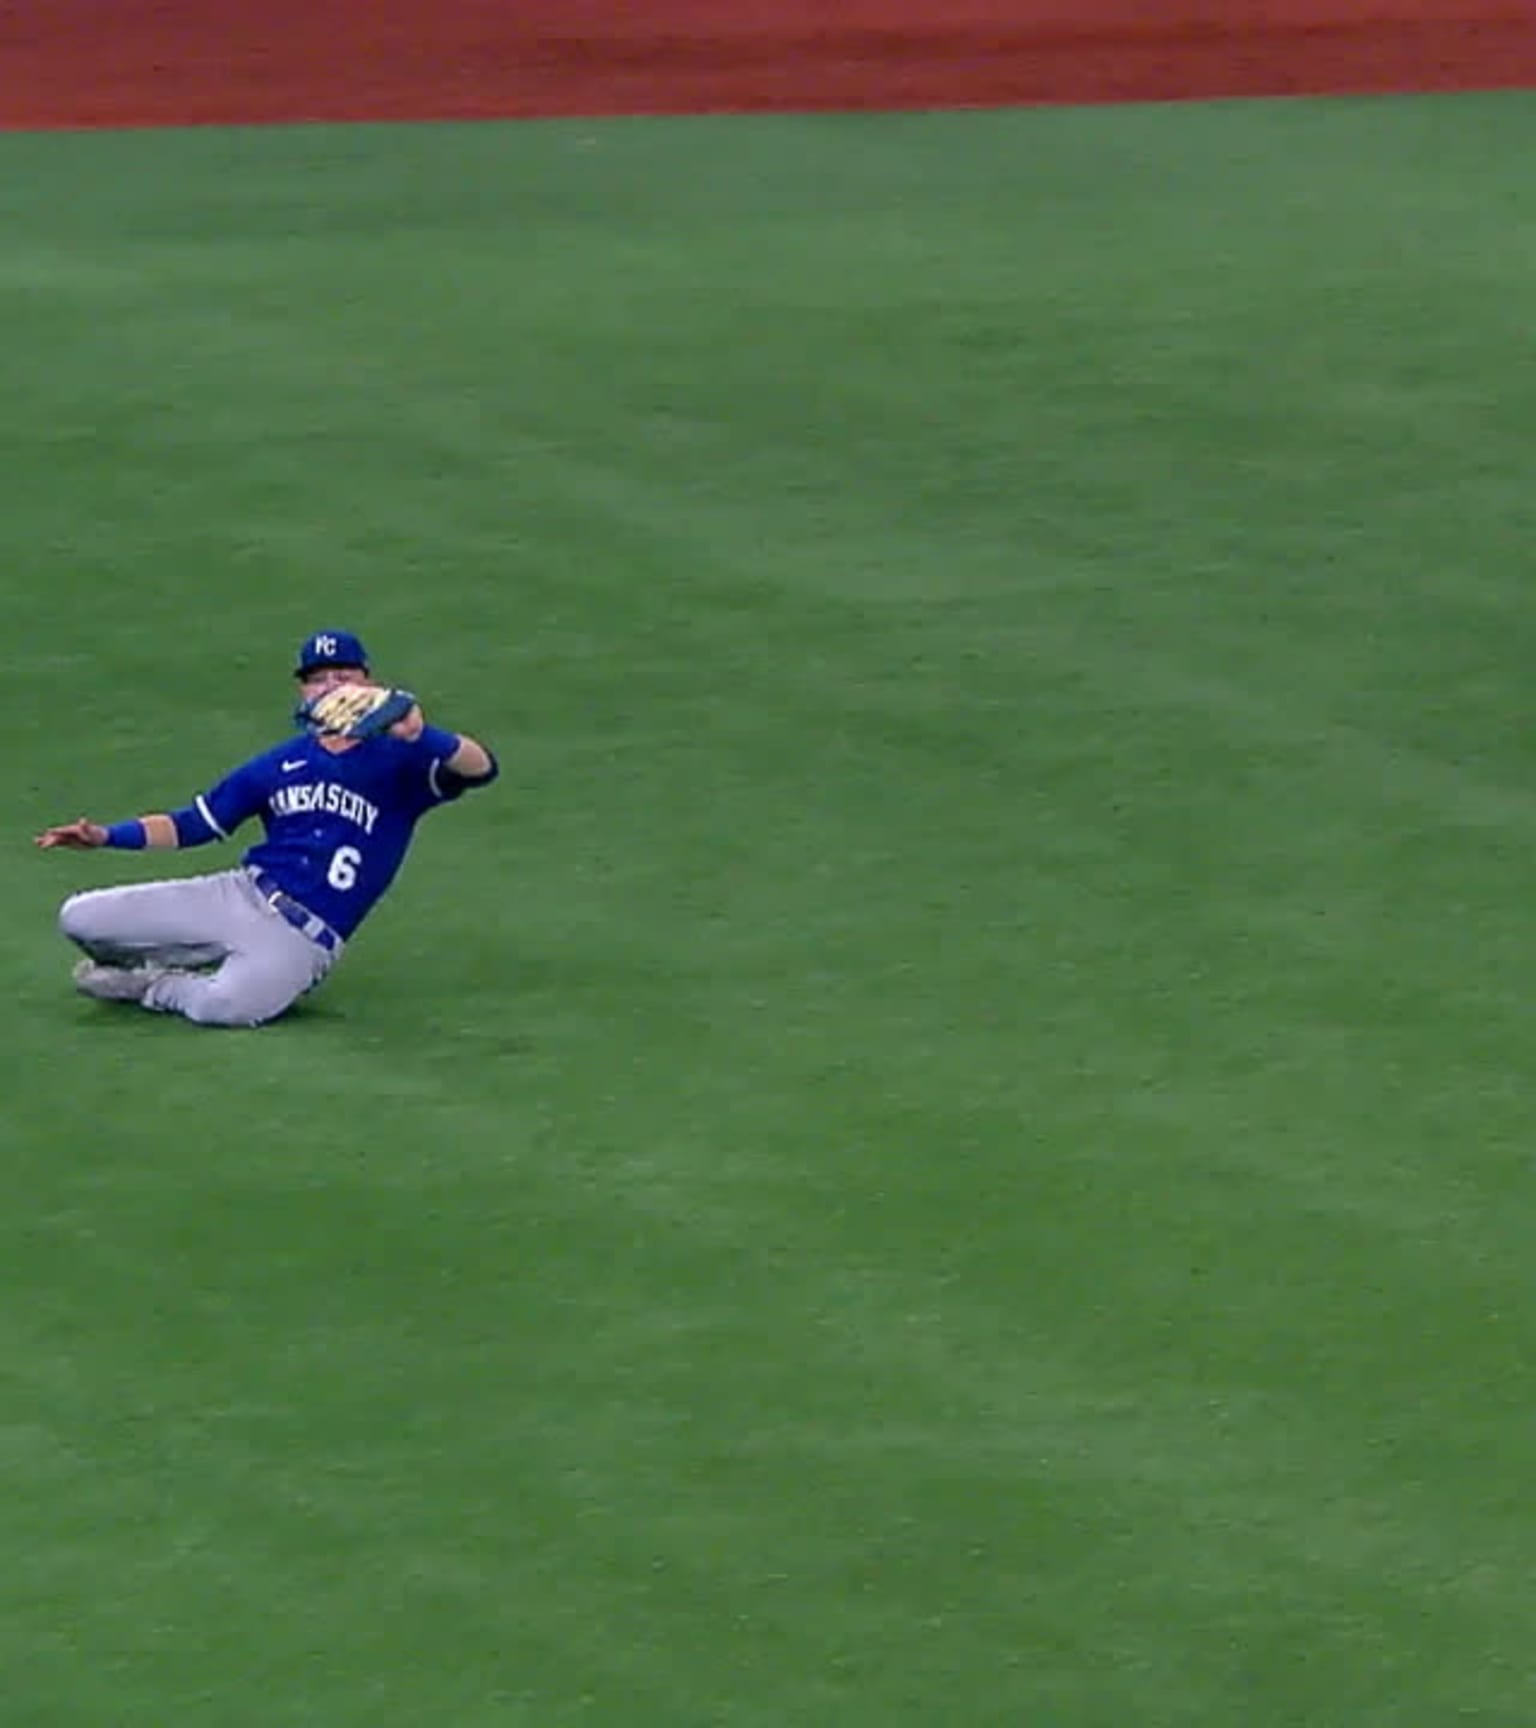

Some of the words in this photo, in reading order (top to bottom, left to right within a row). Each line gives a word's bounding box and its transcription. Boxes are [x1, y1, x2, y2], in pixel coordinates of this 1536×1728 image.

[315, 635, 337, 656] KC
[339, 788, 379, 836] CITY
[327, 846, 362, 891] 6
